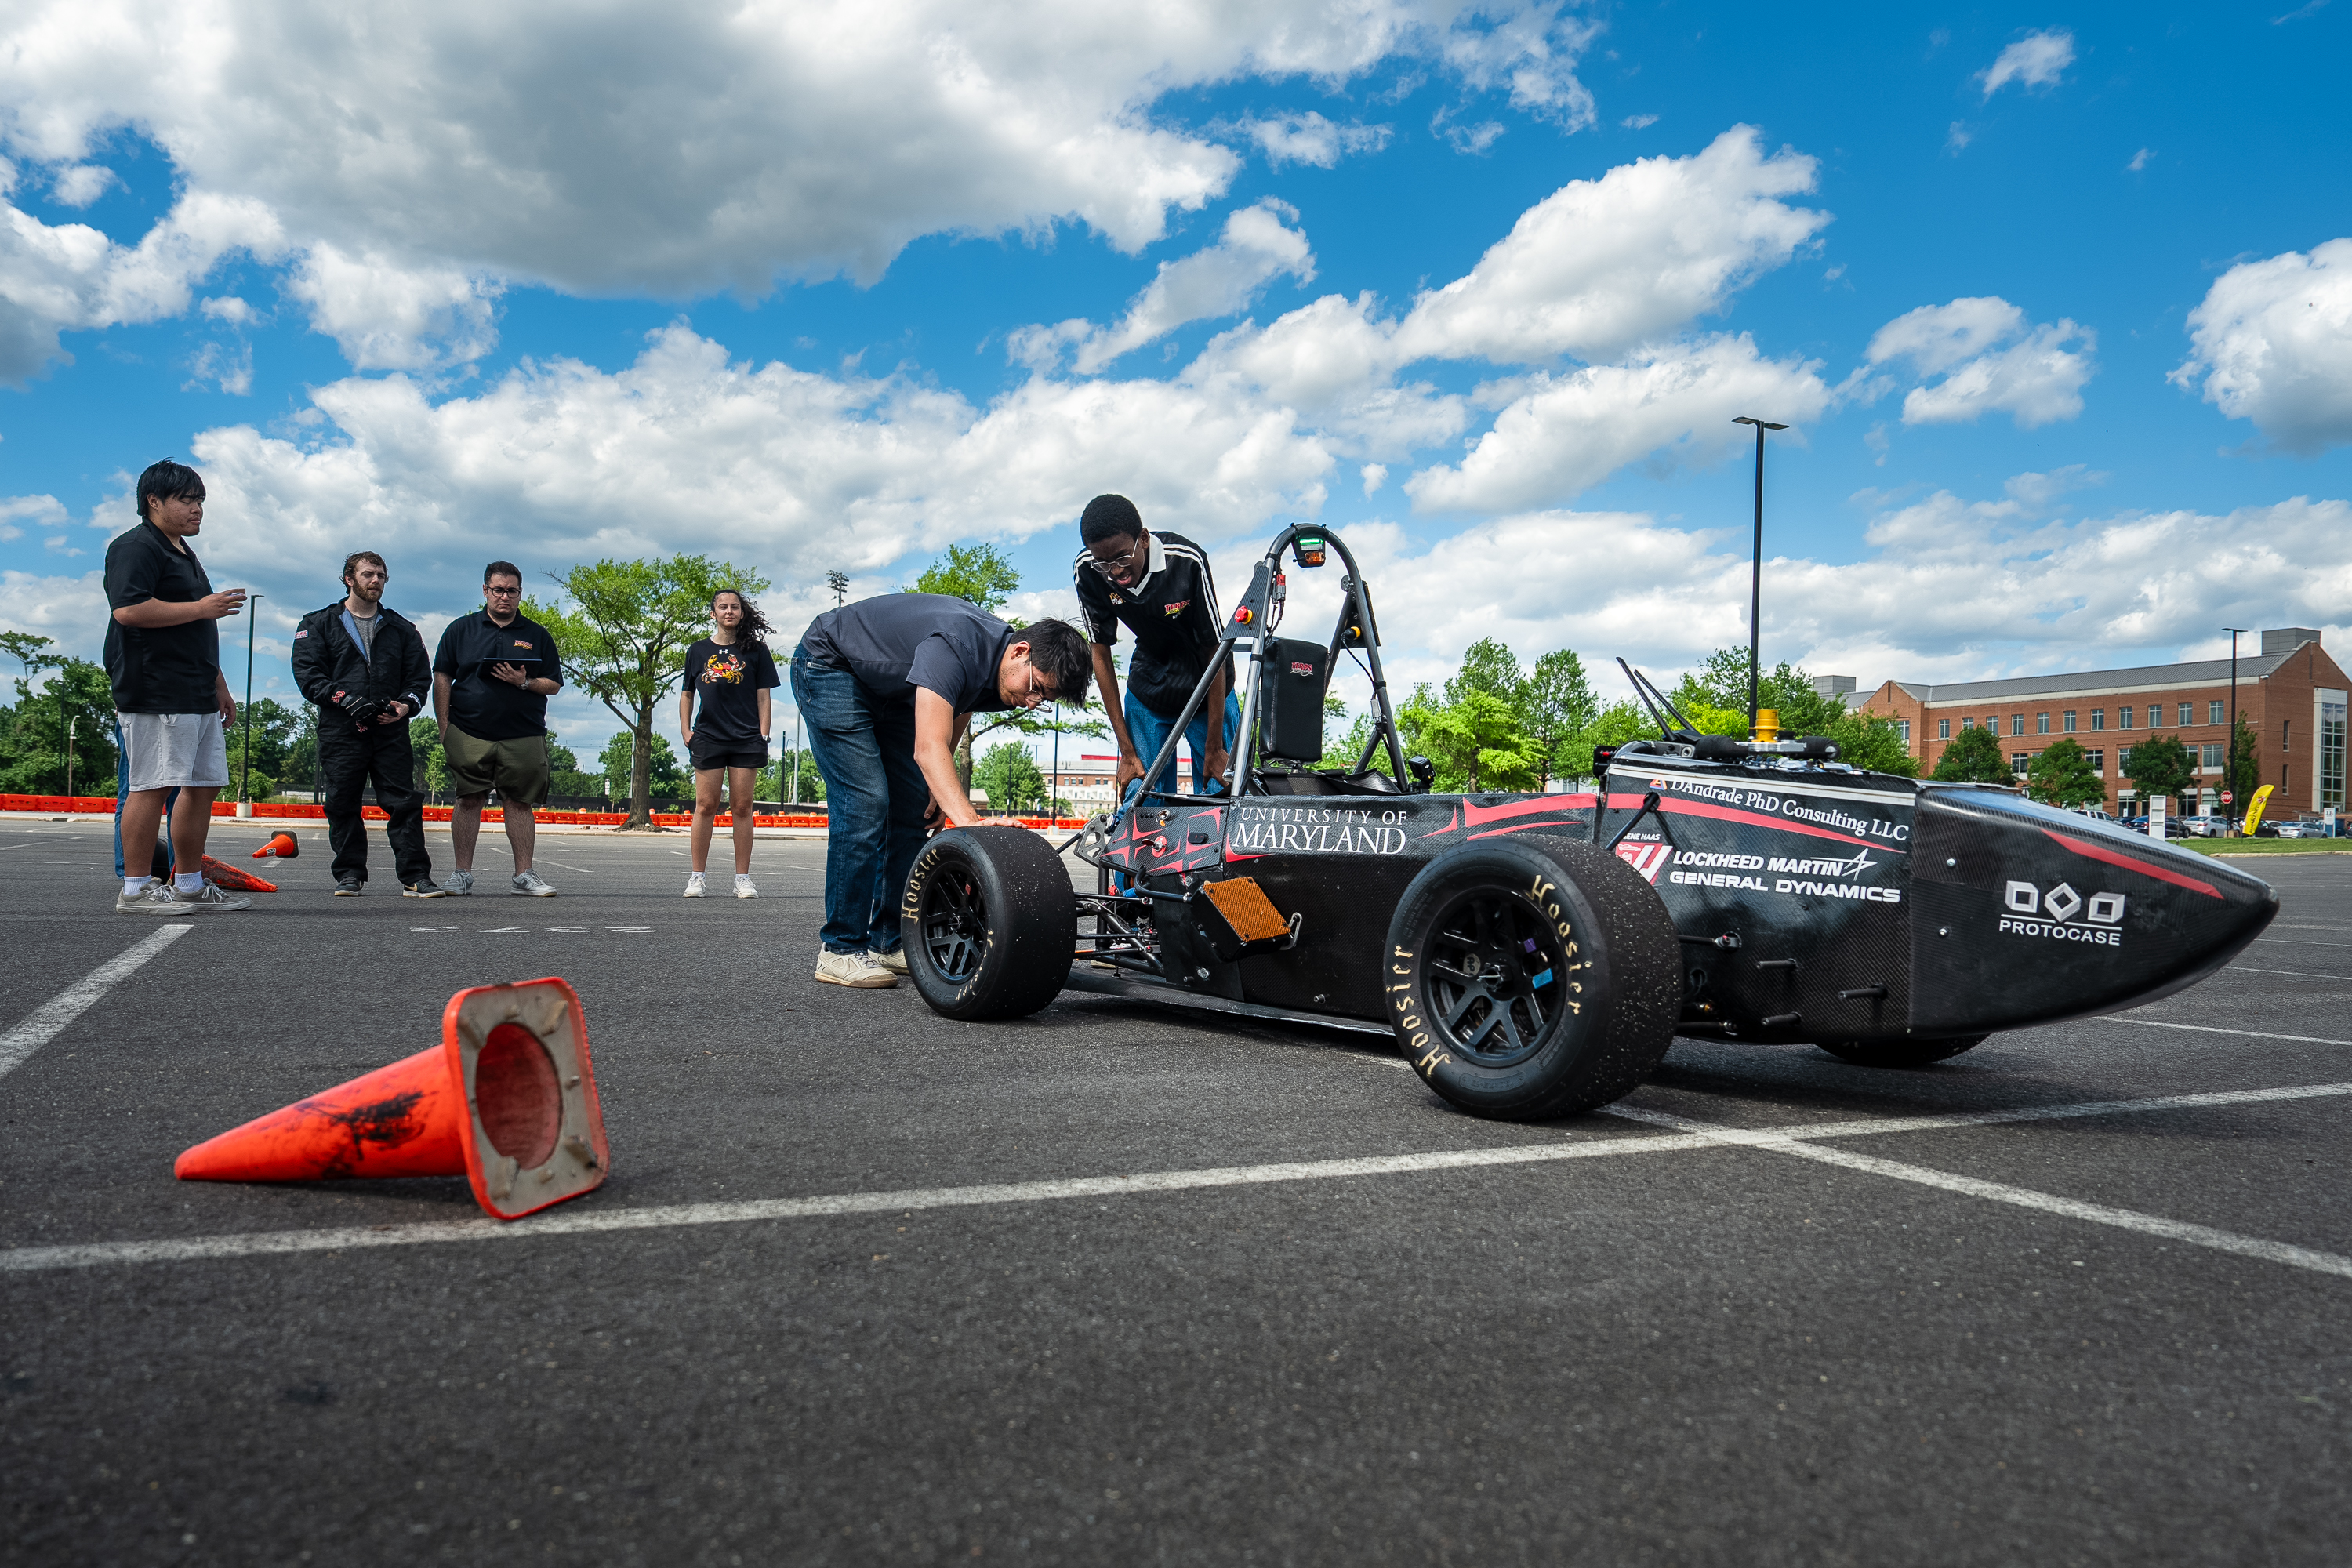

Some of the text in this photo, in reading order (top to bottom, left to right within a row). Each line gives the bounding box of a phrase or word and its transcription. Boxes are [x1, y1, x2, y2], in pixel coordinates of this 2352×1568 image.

[1291, 661, 1312, 672] TERPS
[1241, 808, 1407, 825] UNIVERSITY OF
[1671, 778, 1909, 841] DAndrade PhD Consulting LLC
[1232, 822, 1406, 855] MARYLAND
[1672, 851, 1844, 877] LOCKHEED MARTIN
[1670, 871, 1901, 902] GENERAL DYNAMICS
[1525, 874, 1593, 1014] Hoosier
[1999, 920, 2121, 946] PROTOCASE
[1386, 944, 1451, 1077] Hoosier
